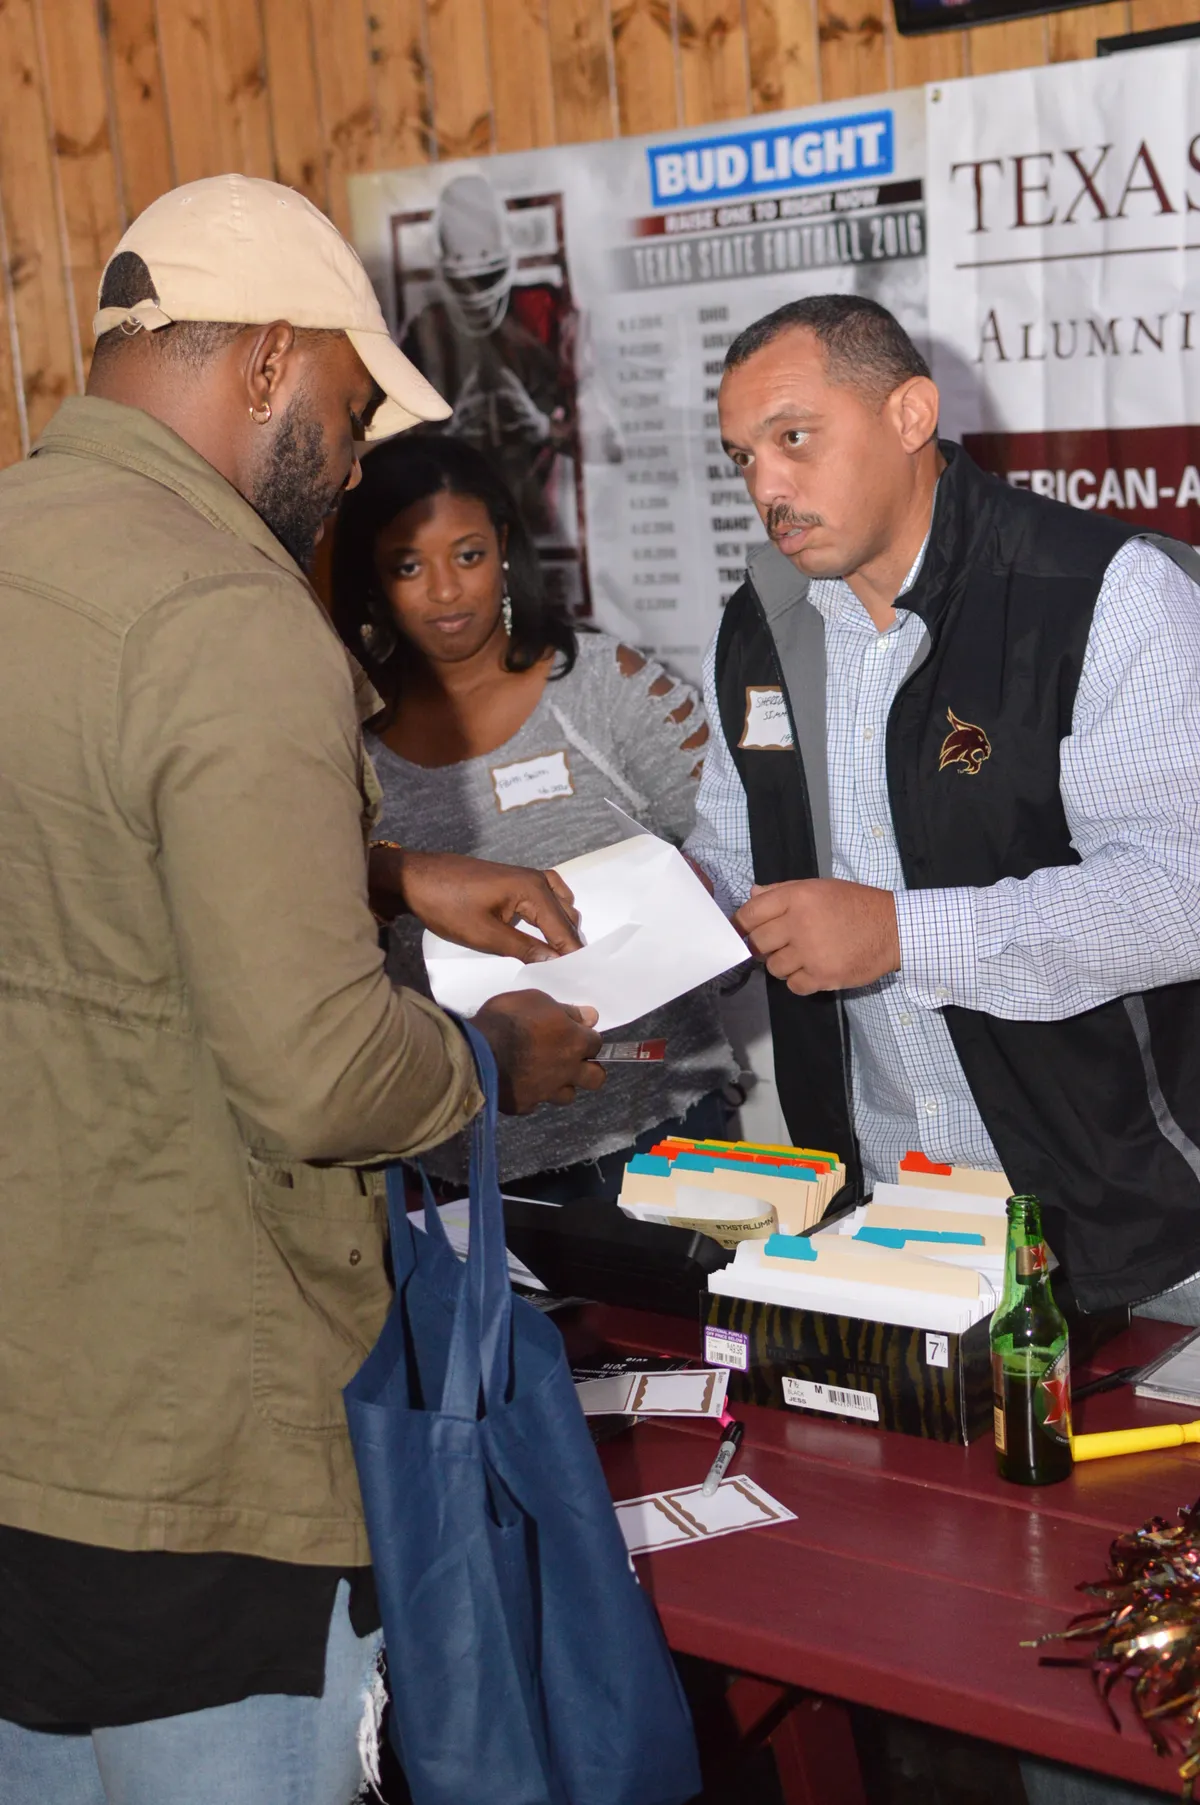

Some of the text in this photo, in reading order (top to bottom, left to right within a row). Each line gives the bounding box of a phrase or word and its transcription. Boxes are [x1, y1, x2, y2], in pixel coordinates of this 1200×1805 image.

[654, 121, 887, 198] BUD LIGHT
[717, 205, 752, 228] ONE
[753, 200, 778, 221] TO
[633, 213, 923, 286] TEXAS STATE FOOTBALL 2016
[993, 465, 1200, 511] FRICAN-A
[814, 1384, 823, 1394] M
